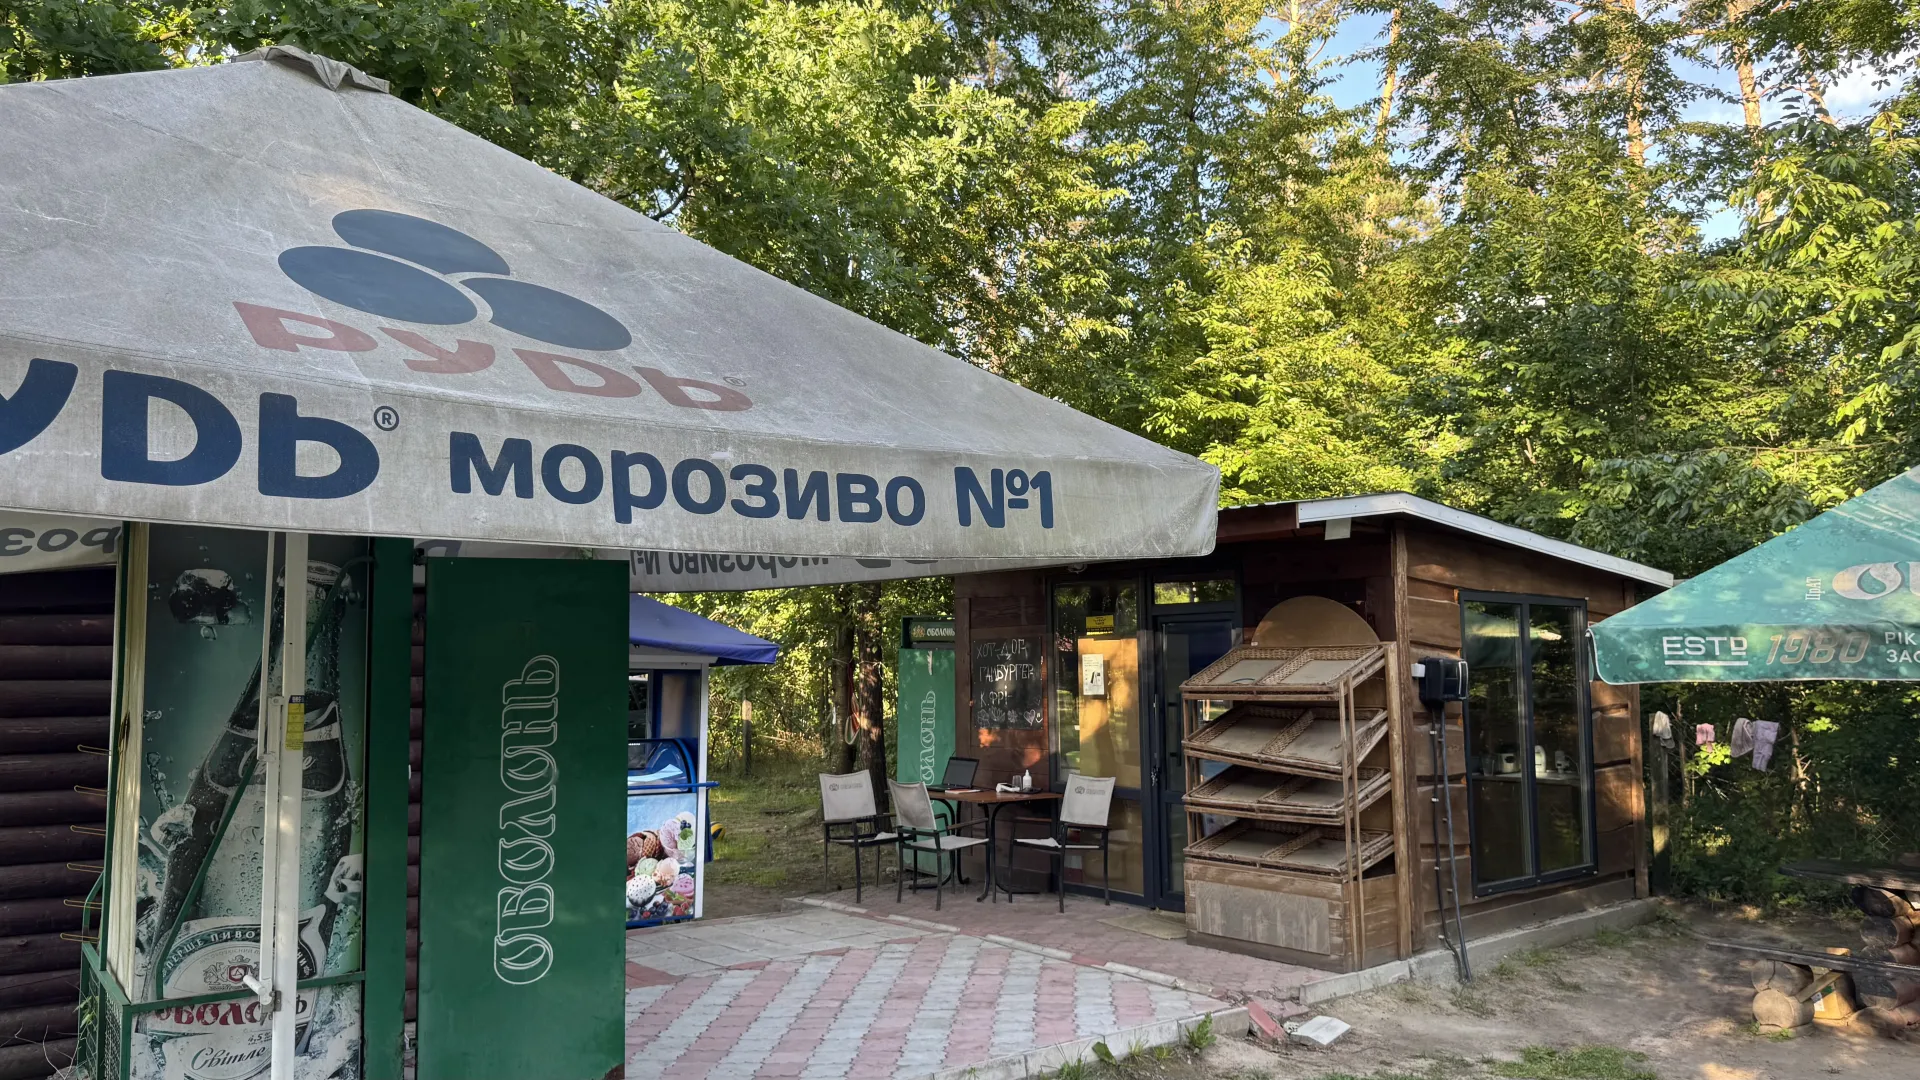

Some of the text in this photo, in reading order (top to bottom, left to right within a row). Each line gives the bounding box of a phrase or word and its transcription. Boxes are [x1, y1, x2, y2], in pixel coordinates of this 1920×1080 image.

[450, 432, 926, 524] морозиво
[1766, 631, 1871, 665] 1980
[1884, 632, 1917, 646] РІК
